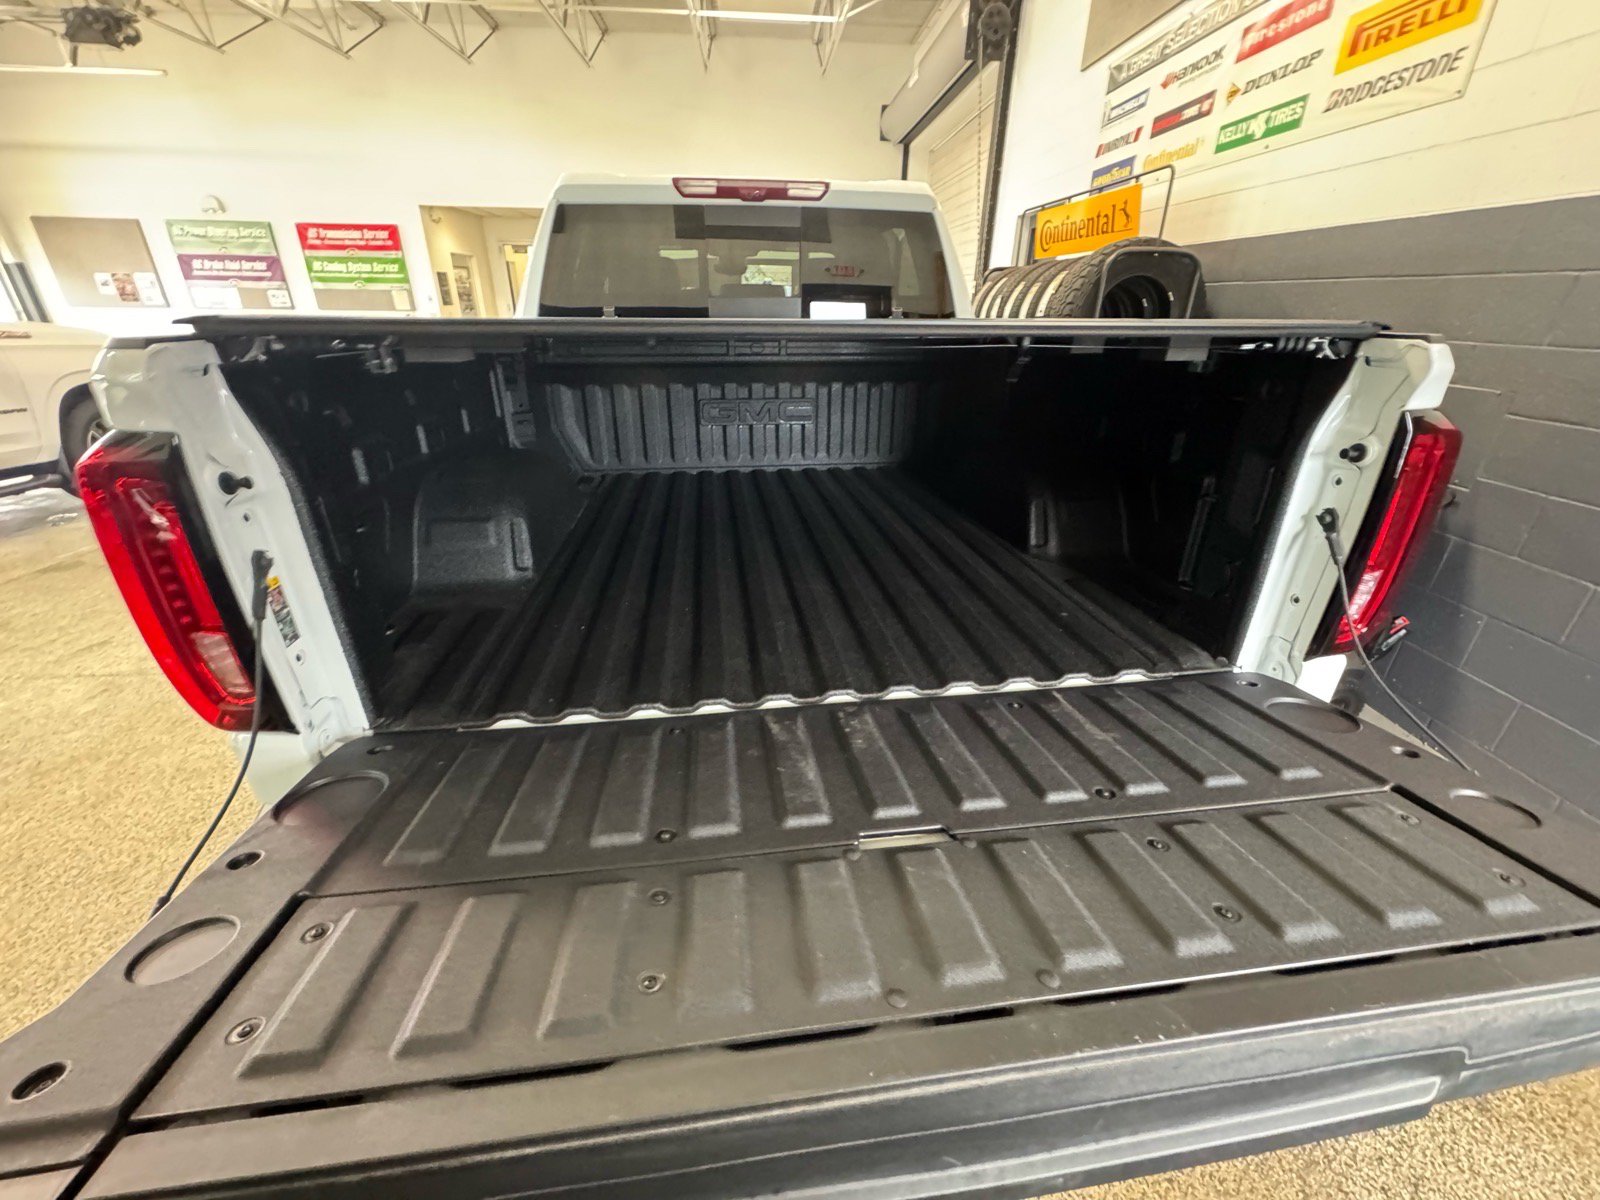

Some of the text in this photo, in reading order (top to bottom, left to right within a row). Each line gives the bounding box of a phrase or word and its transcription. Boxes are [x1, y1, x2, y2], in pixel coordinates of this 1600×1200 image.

[1243, 0, 1328, 47] Firestone
[1347, 0, 1468, 57] PIRELLI
[1241, 48, 1324, 96] DUNLOP
[1322, 45, 1470, 114] BRIDGESTONE
[1220, 119, 1250, 144] KELLY
[1268, 100, 1305, 128] TIRES
[1143, 137, 1200, 171] Continental
[1039, 203, 1117, 253] Continental
[701, 400, 814, 424] GMC
